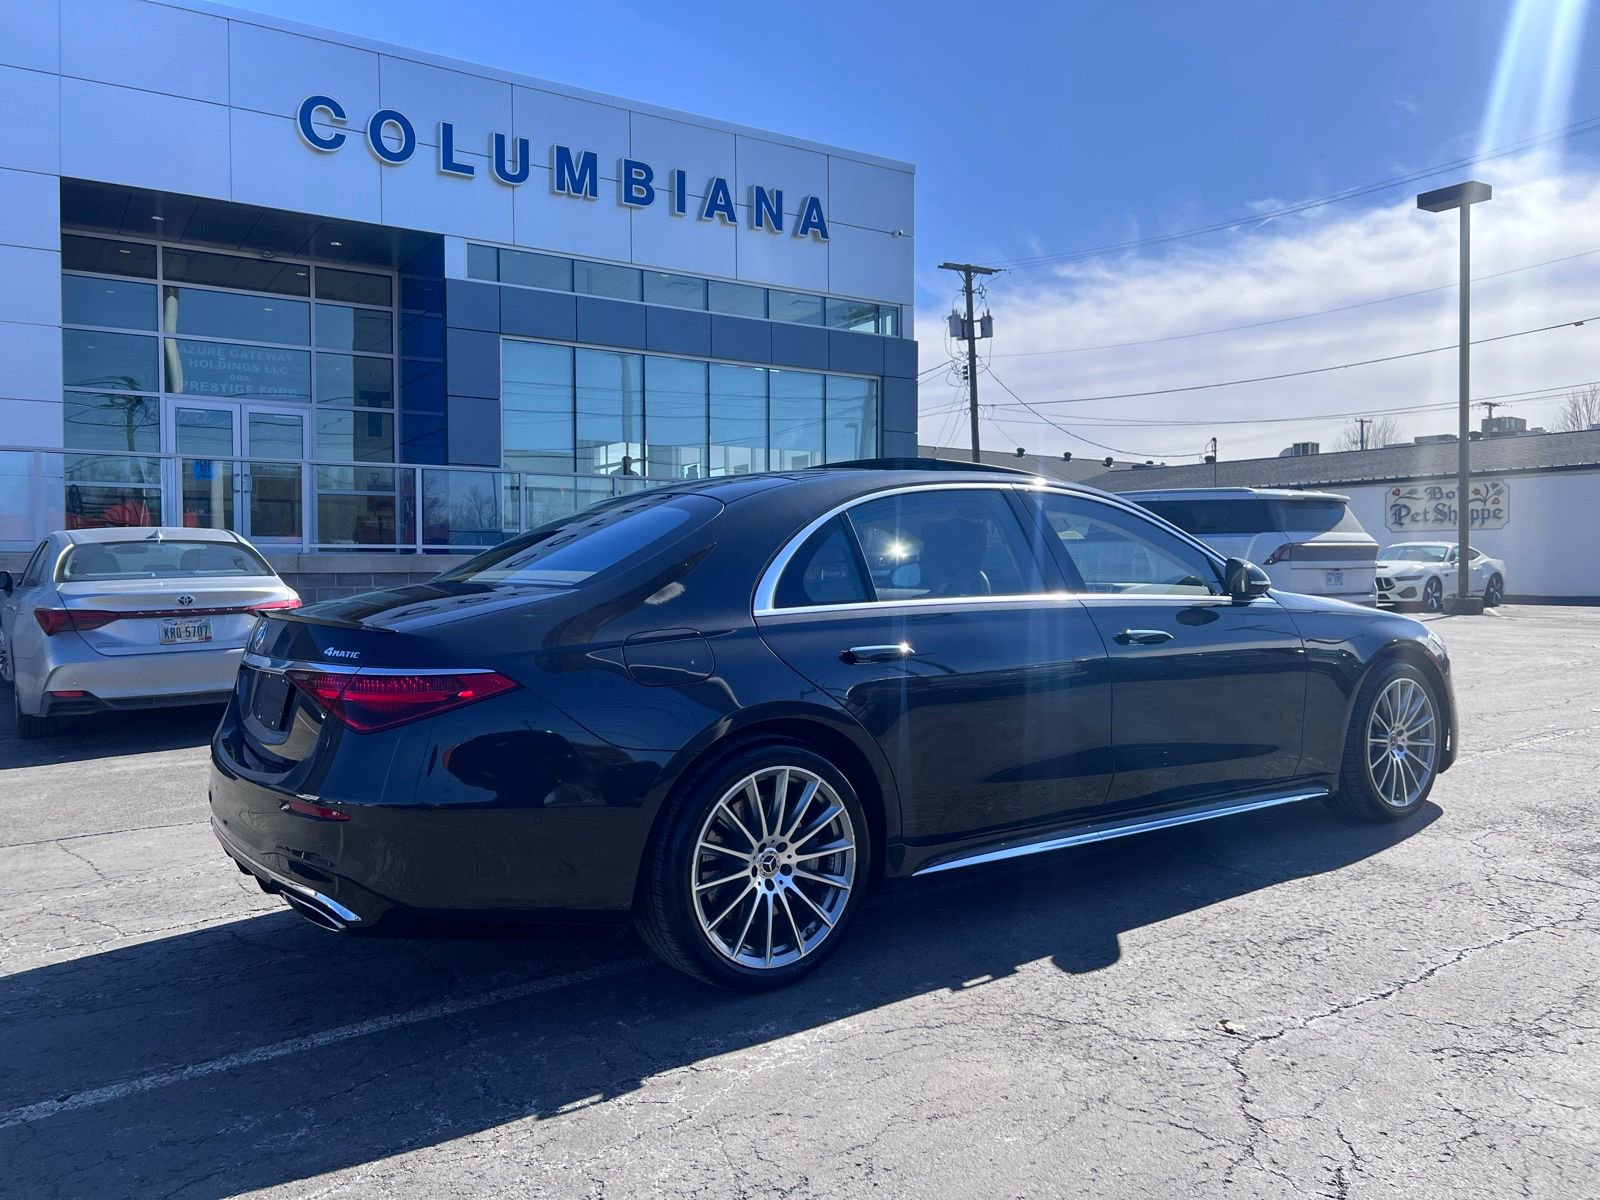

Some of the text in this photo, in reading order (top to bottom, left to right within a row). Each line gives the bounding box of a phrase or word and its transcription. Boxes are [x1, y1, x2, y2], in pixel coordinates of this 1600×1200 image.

[296, 94, 830, 242] COLUMBIANA
[179, 344, 293, 362] AZURE GATEWAY
[188, 357, 288, 375] HOLDINGS LLC
[181, 380, 298, 398] PRESTIGE FORD
[1390, 502, 1504, 526] Pet Shppe
[185, 625, 208, 637] 5707
[323, 646, 361, 659] 4MATIC
